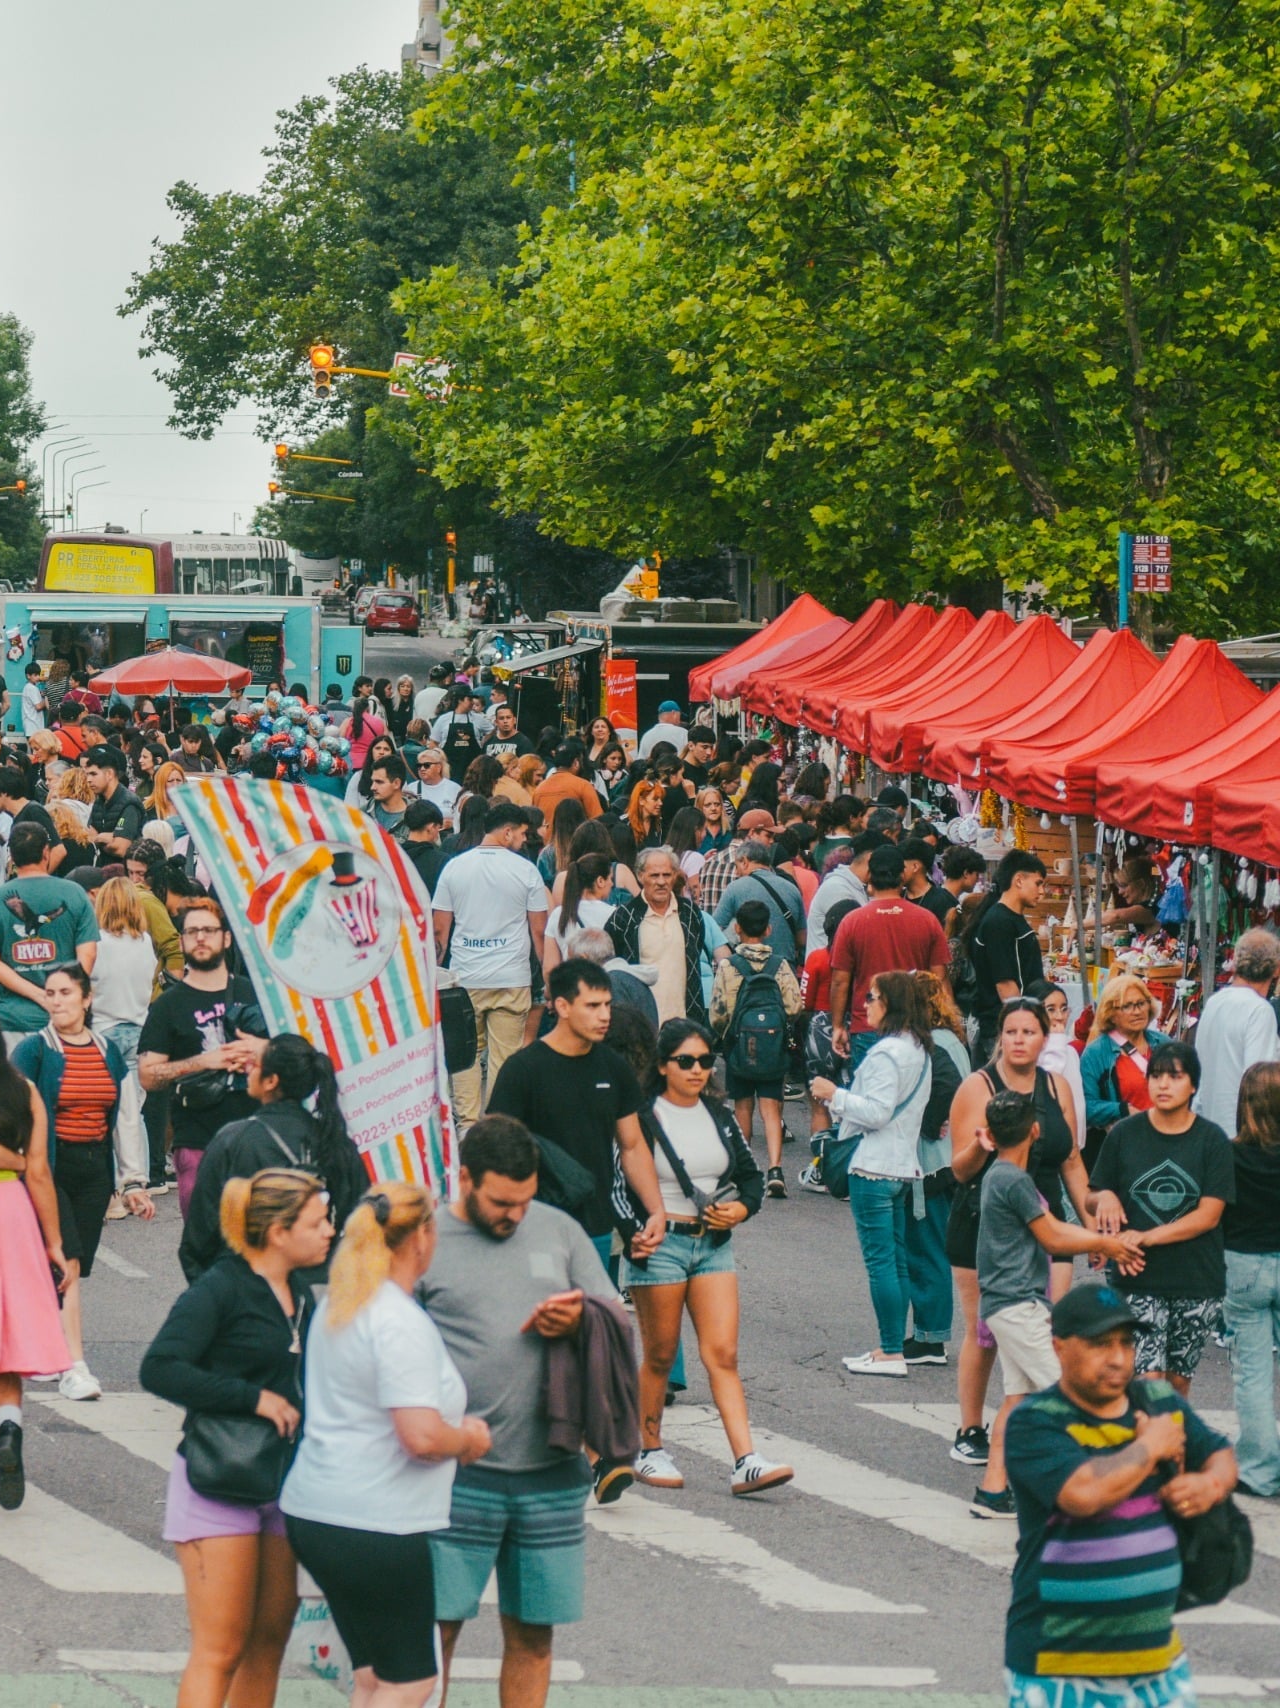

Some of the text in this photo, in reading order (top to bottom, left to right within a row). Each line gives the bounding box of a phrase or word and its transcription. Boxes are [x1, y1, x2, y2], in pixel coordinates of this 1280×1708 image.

[1135, 535, 1169, 543] 511 512
[1155, 565, 1169, 573] 717
[462, 937, 507, 948] DIRECTV
[16, 943, 52, 960] RVCA
[357, 1058, 406, 1086] Pochoclos
[345, 1107, 364, 1121] Los
[365, 1083, 413, 1110] Pochoclos
